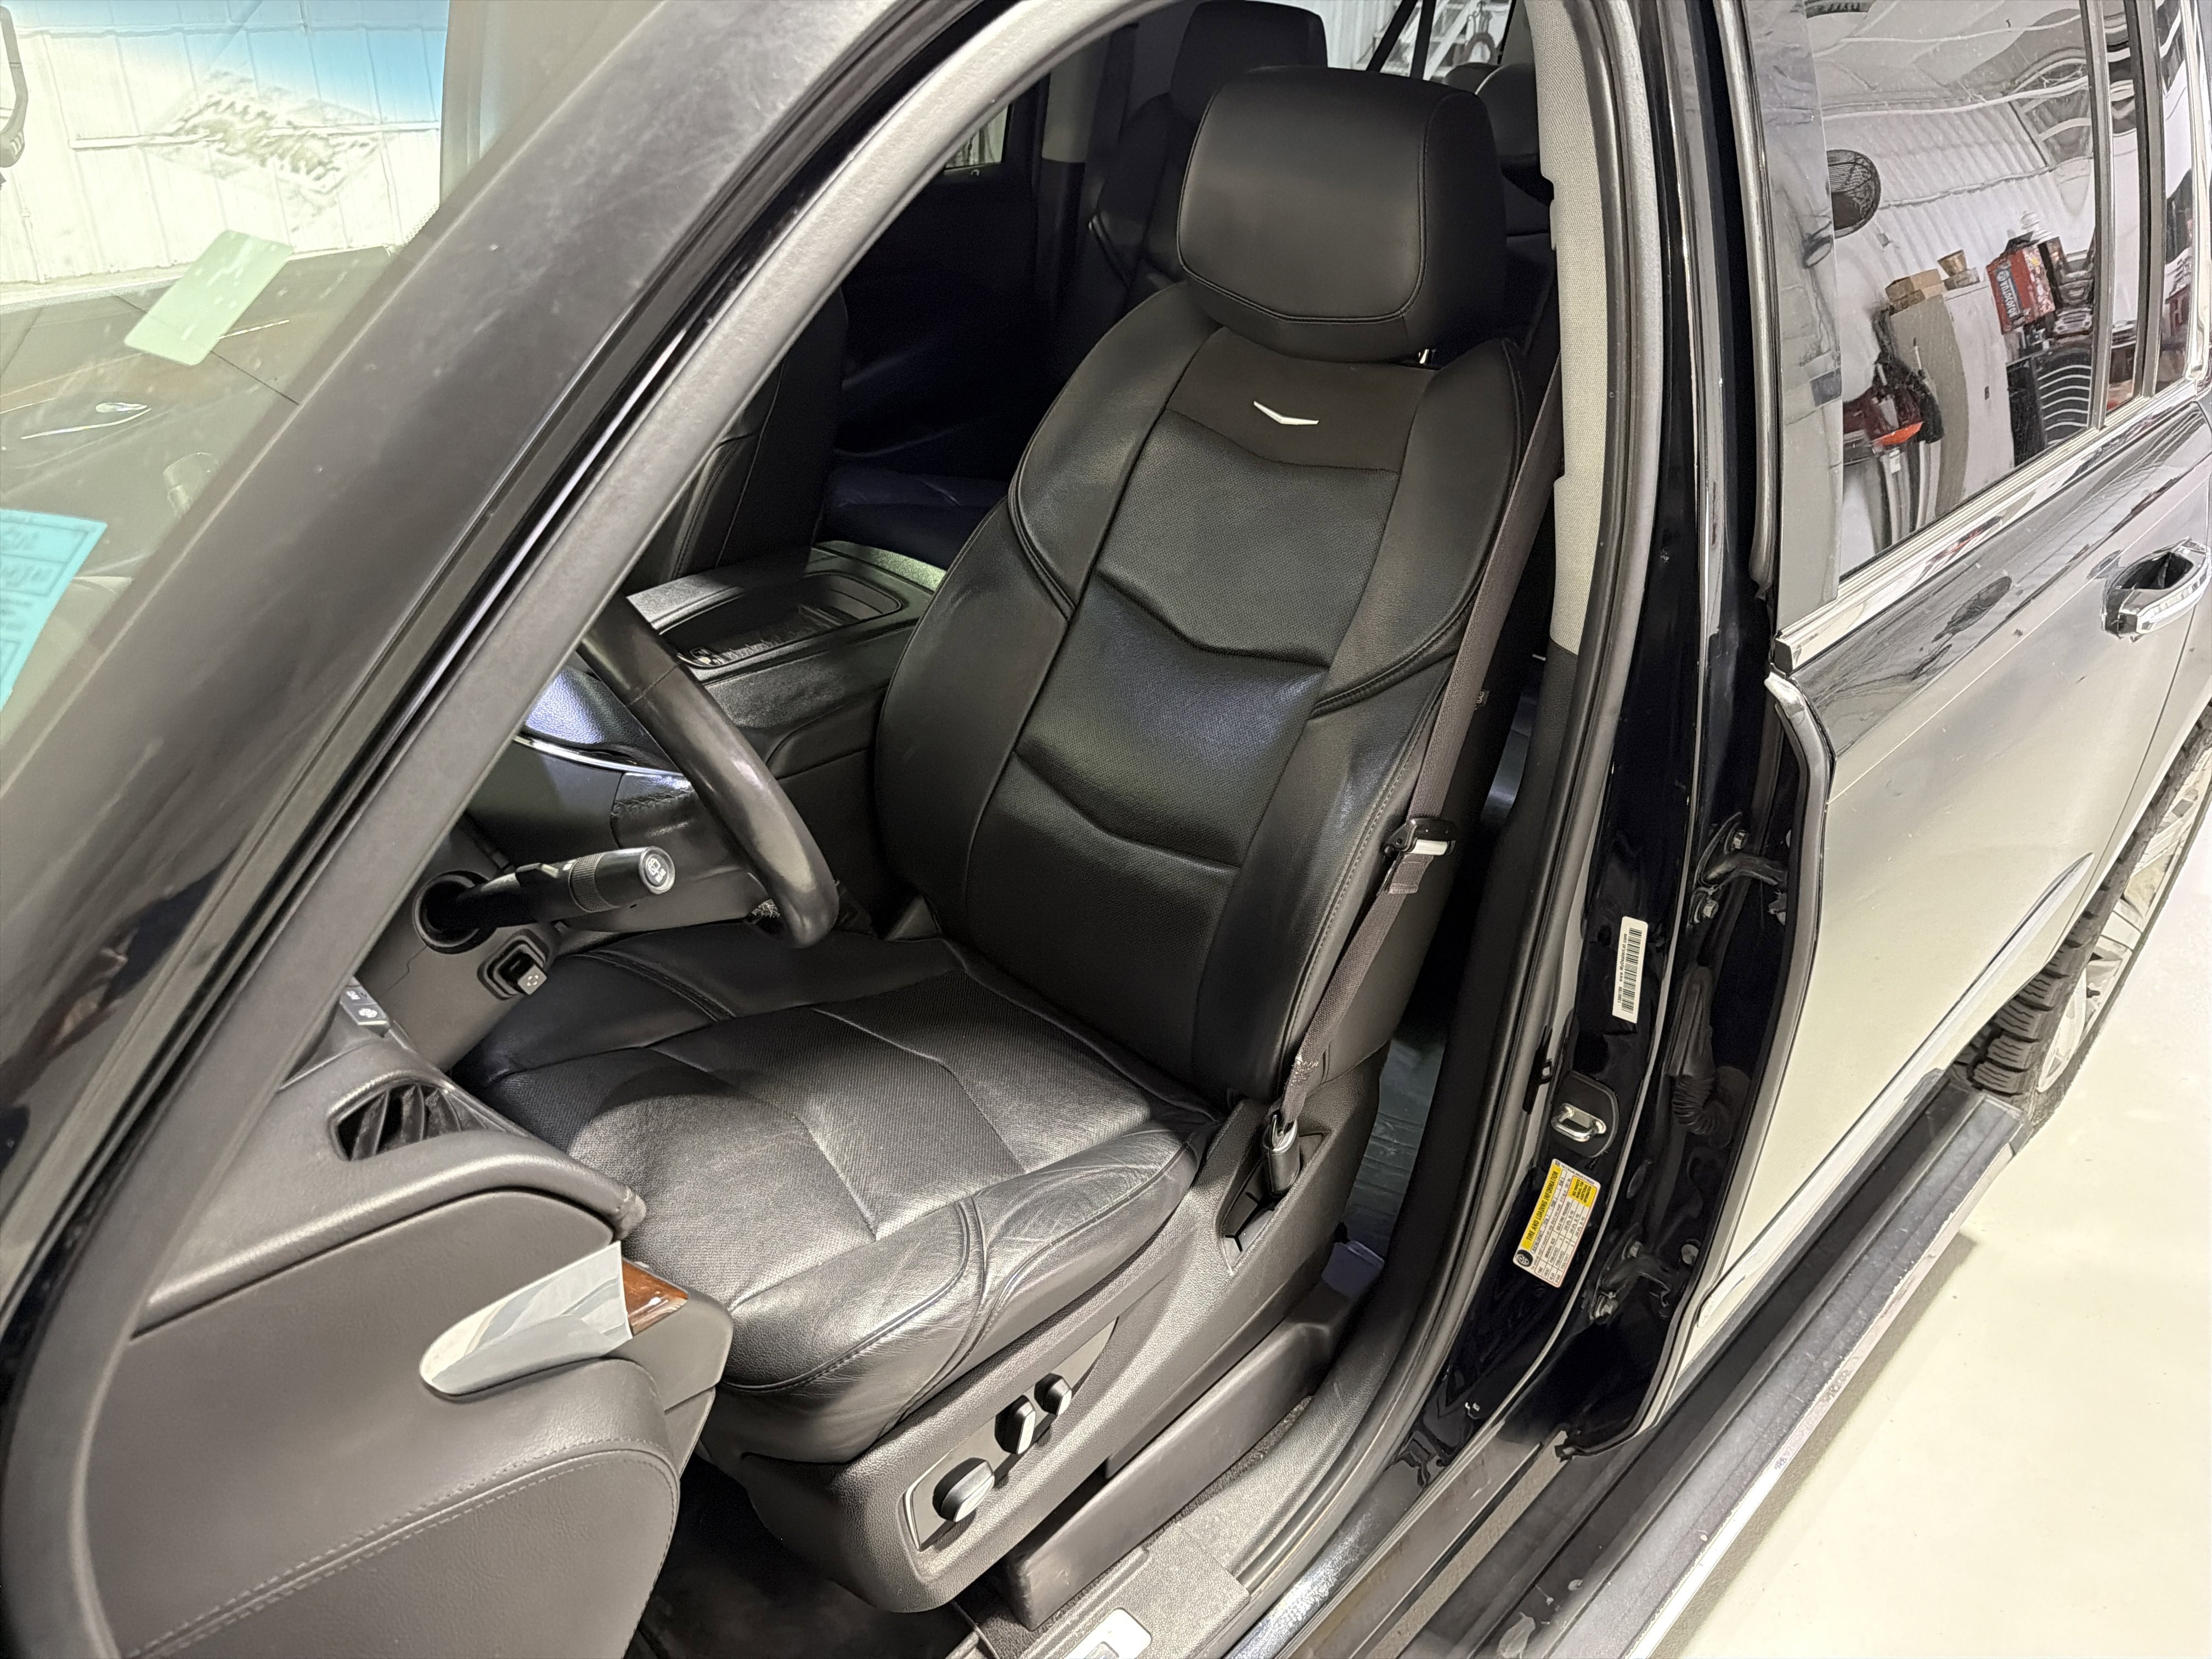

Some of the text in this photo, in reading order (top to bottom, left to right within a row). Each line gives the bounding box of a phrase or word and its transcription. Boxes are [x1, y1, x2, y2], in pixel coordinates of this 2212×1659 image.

[1526, 1230, 1535, 1241] TIRE
[1531, 1220, 1539, 1231] AND
[1535, 1201, 1548, 1220] LOADING
[1543, 1171, 1559, 1200] INFORMATION
